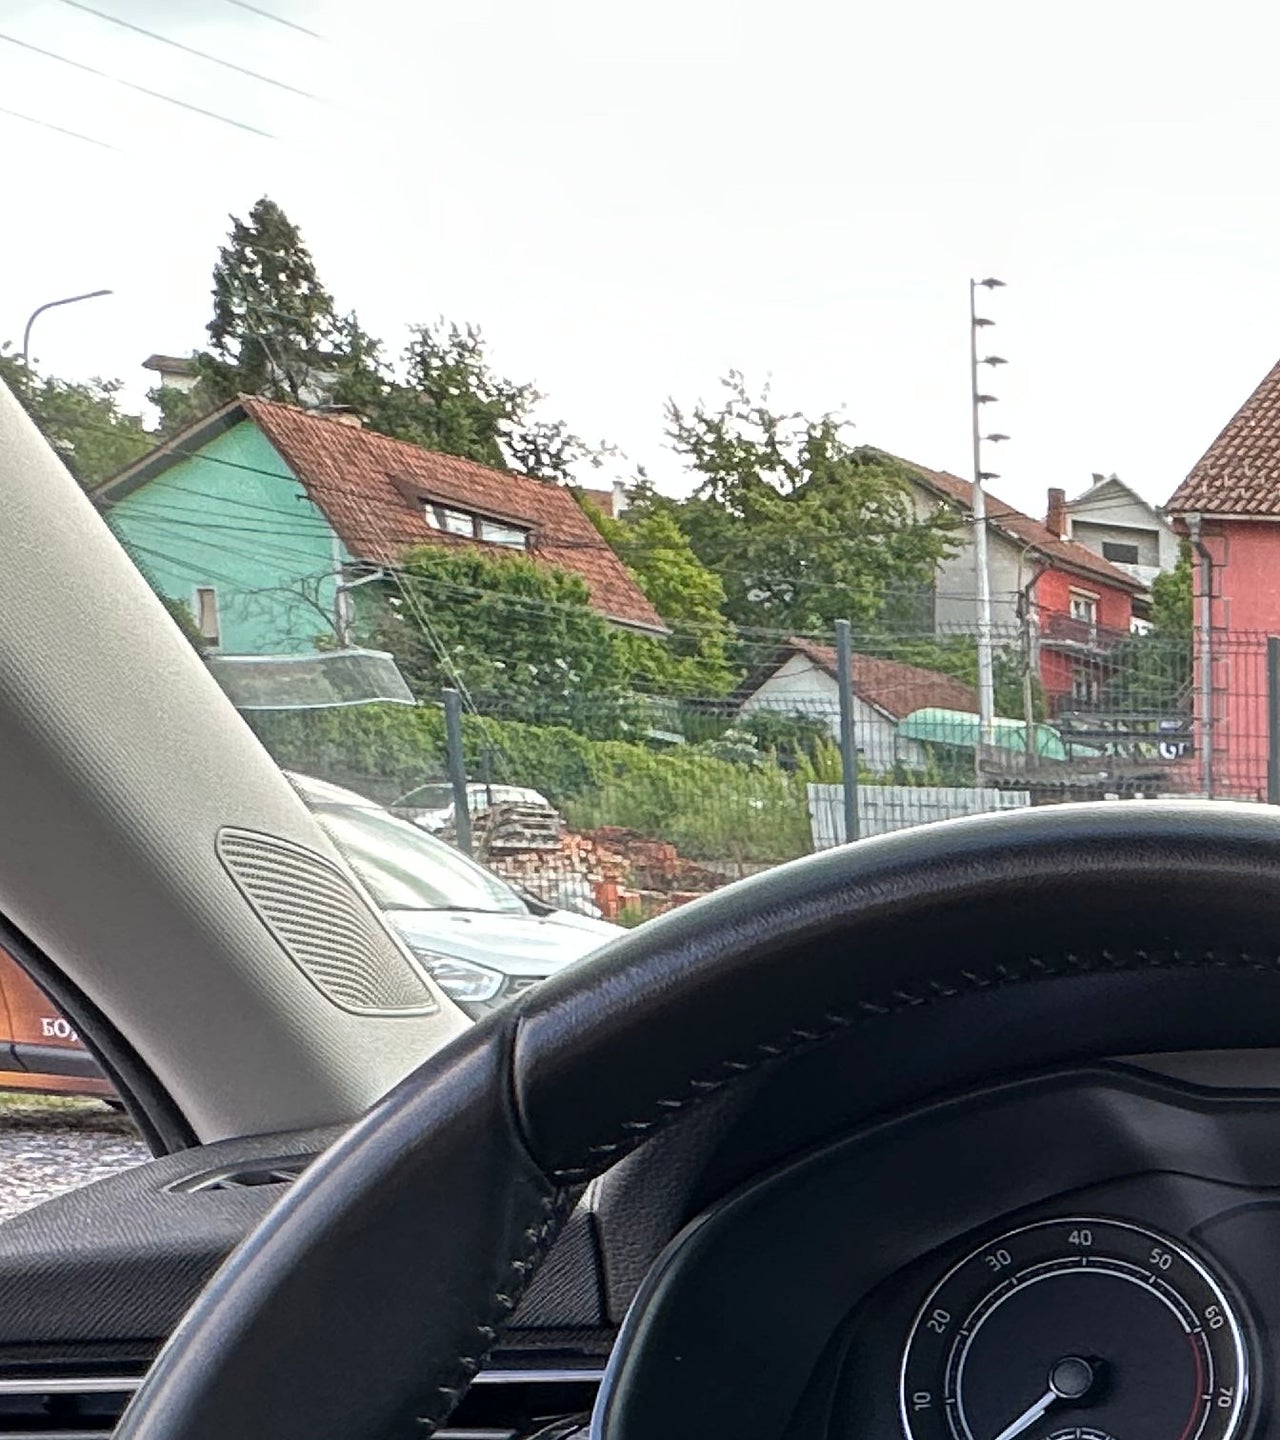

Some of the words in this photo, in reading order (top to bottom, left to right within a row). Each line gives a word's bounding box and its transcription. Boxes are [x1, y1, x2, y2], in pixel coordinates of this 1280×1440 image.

[1068, 1230, 1092, 1246] 40
[985, 1249, 1012, 1271] 30
[1149, 1248, 1173, 1270] 50
[927, 1309, 951, 1334] 20
[1204, 1304, 1223, 1330] 60
[914, 1391, 931, 1411] 10
[1217, 1386, 1233, 1408] 70
